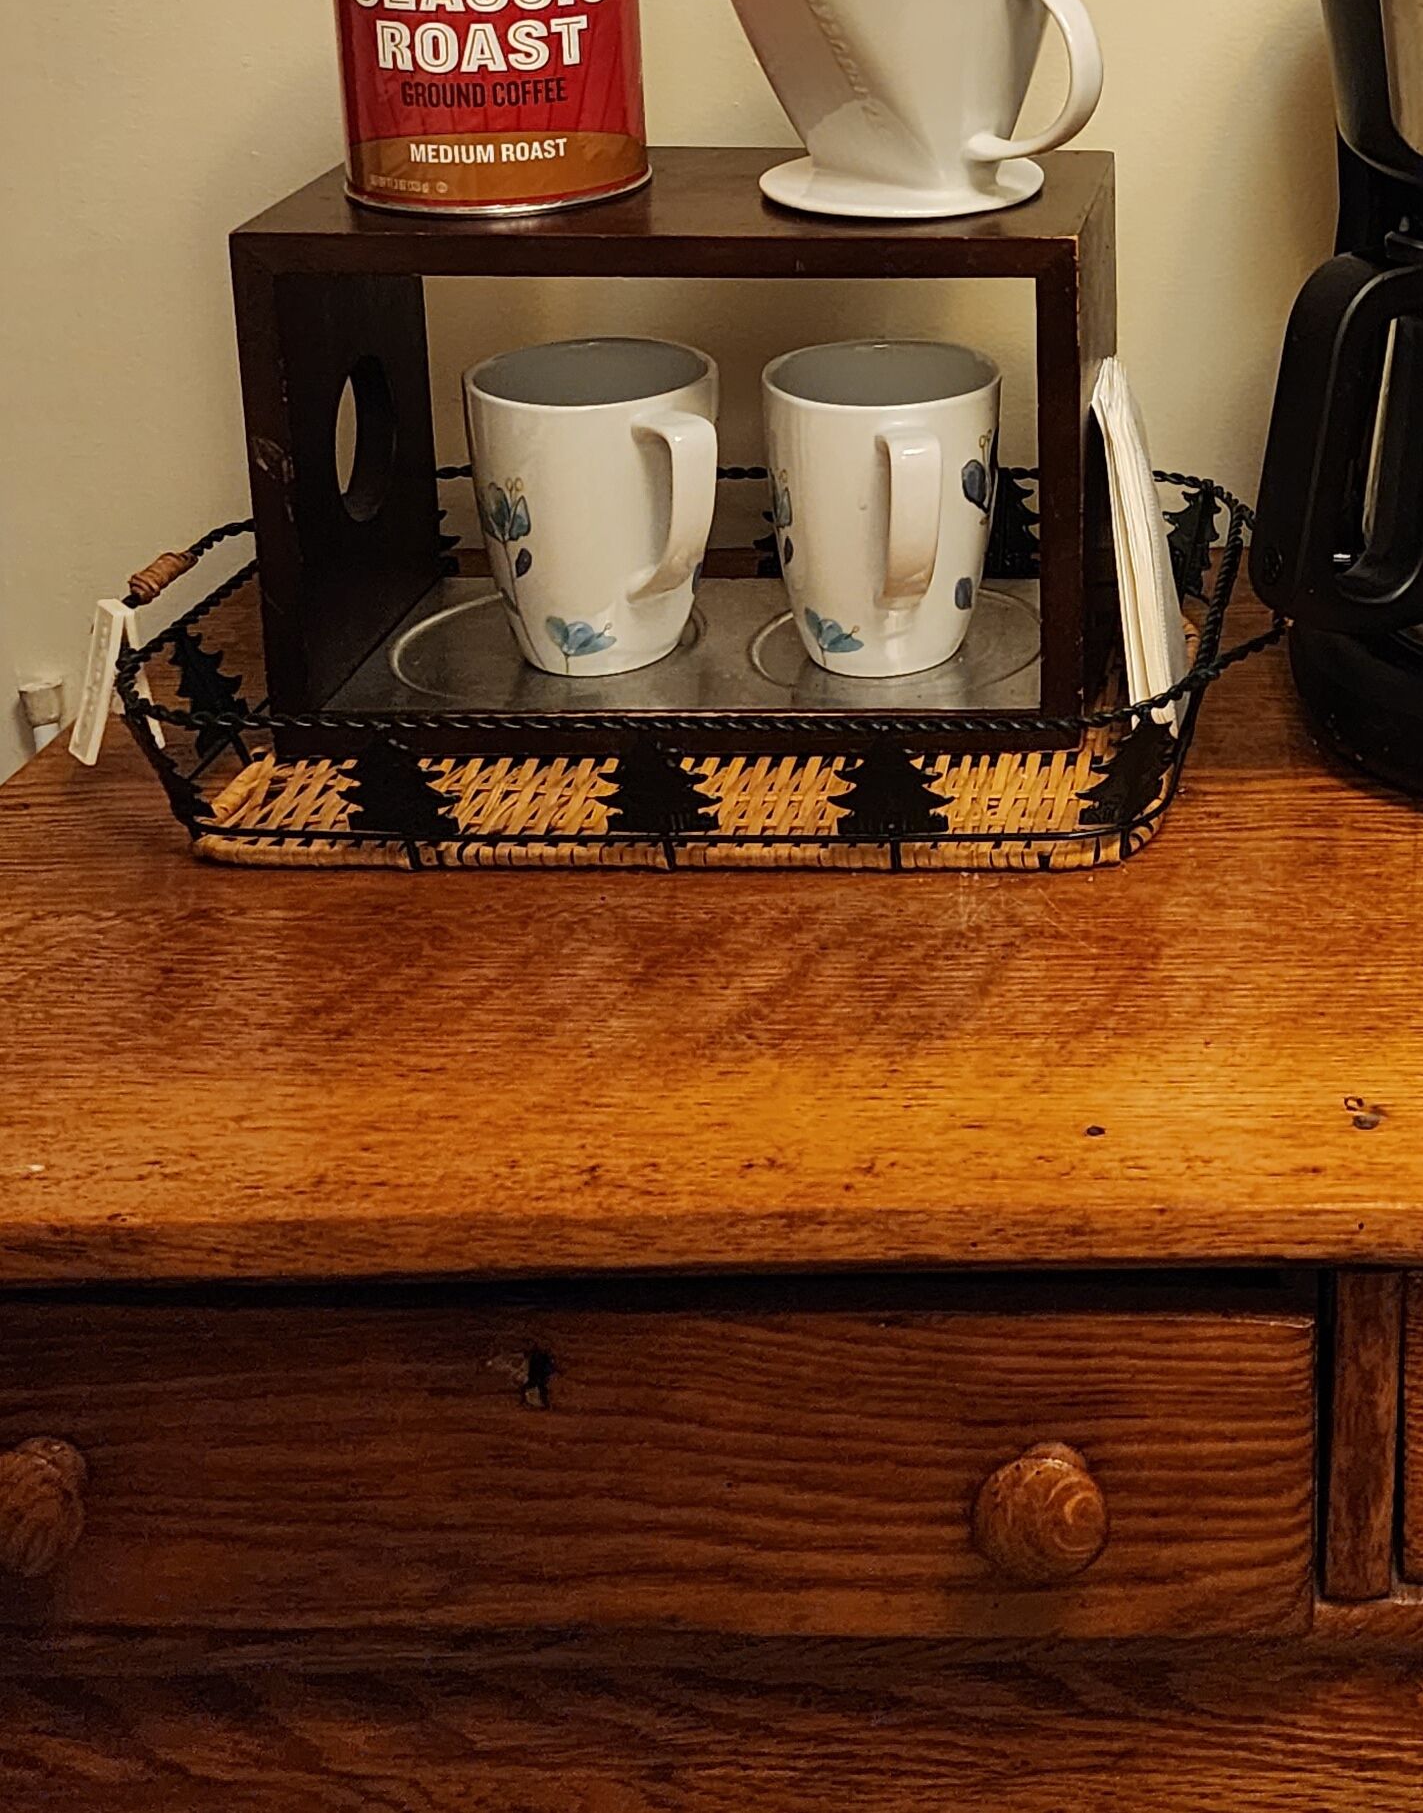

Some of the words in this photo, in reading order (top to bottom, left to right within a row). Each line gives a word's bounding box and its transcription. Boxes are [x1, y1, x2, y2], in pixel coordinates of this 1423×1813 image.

[376, 14, 590, 74] ROAST
[400, 80, 487, 109] GROUND
[492, 76, 569, 107] COFFEE
[409, 142, 495, 165] MEDIUM
[500, 137, 568, 163] ROAST
